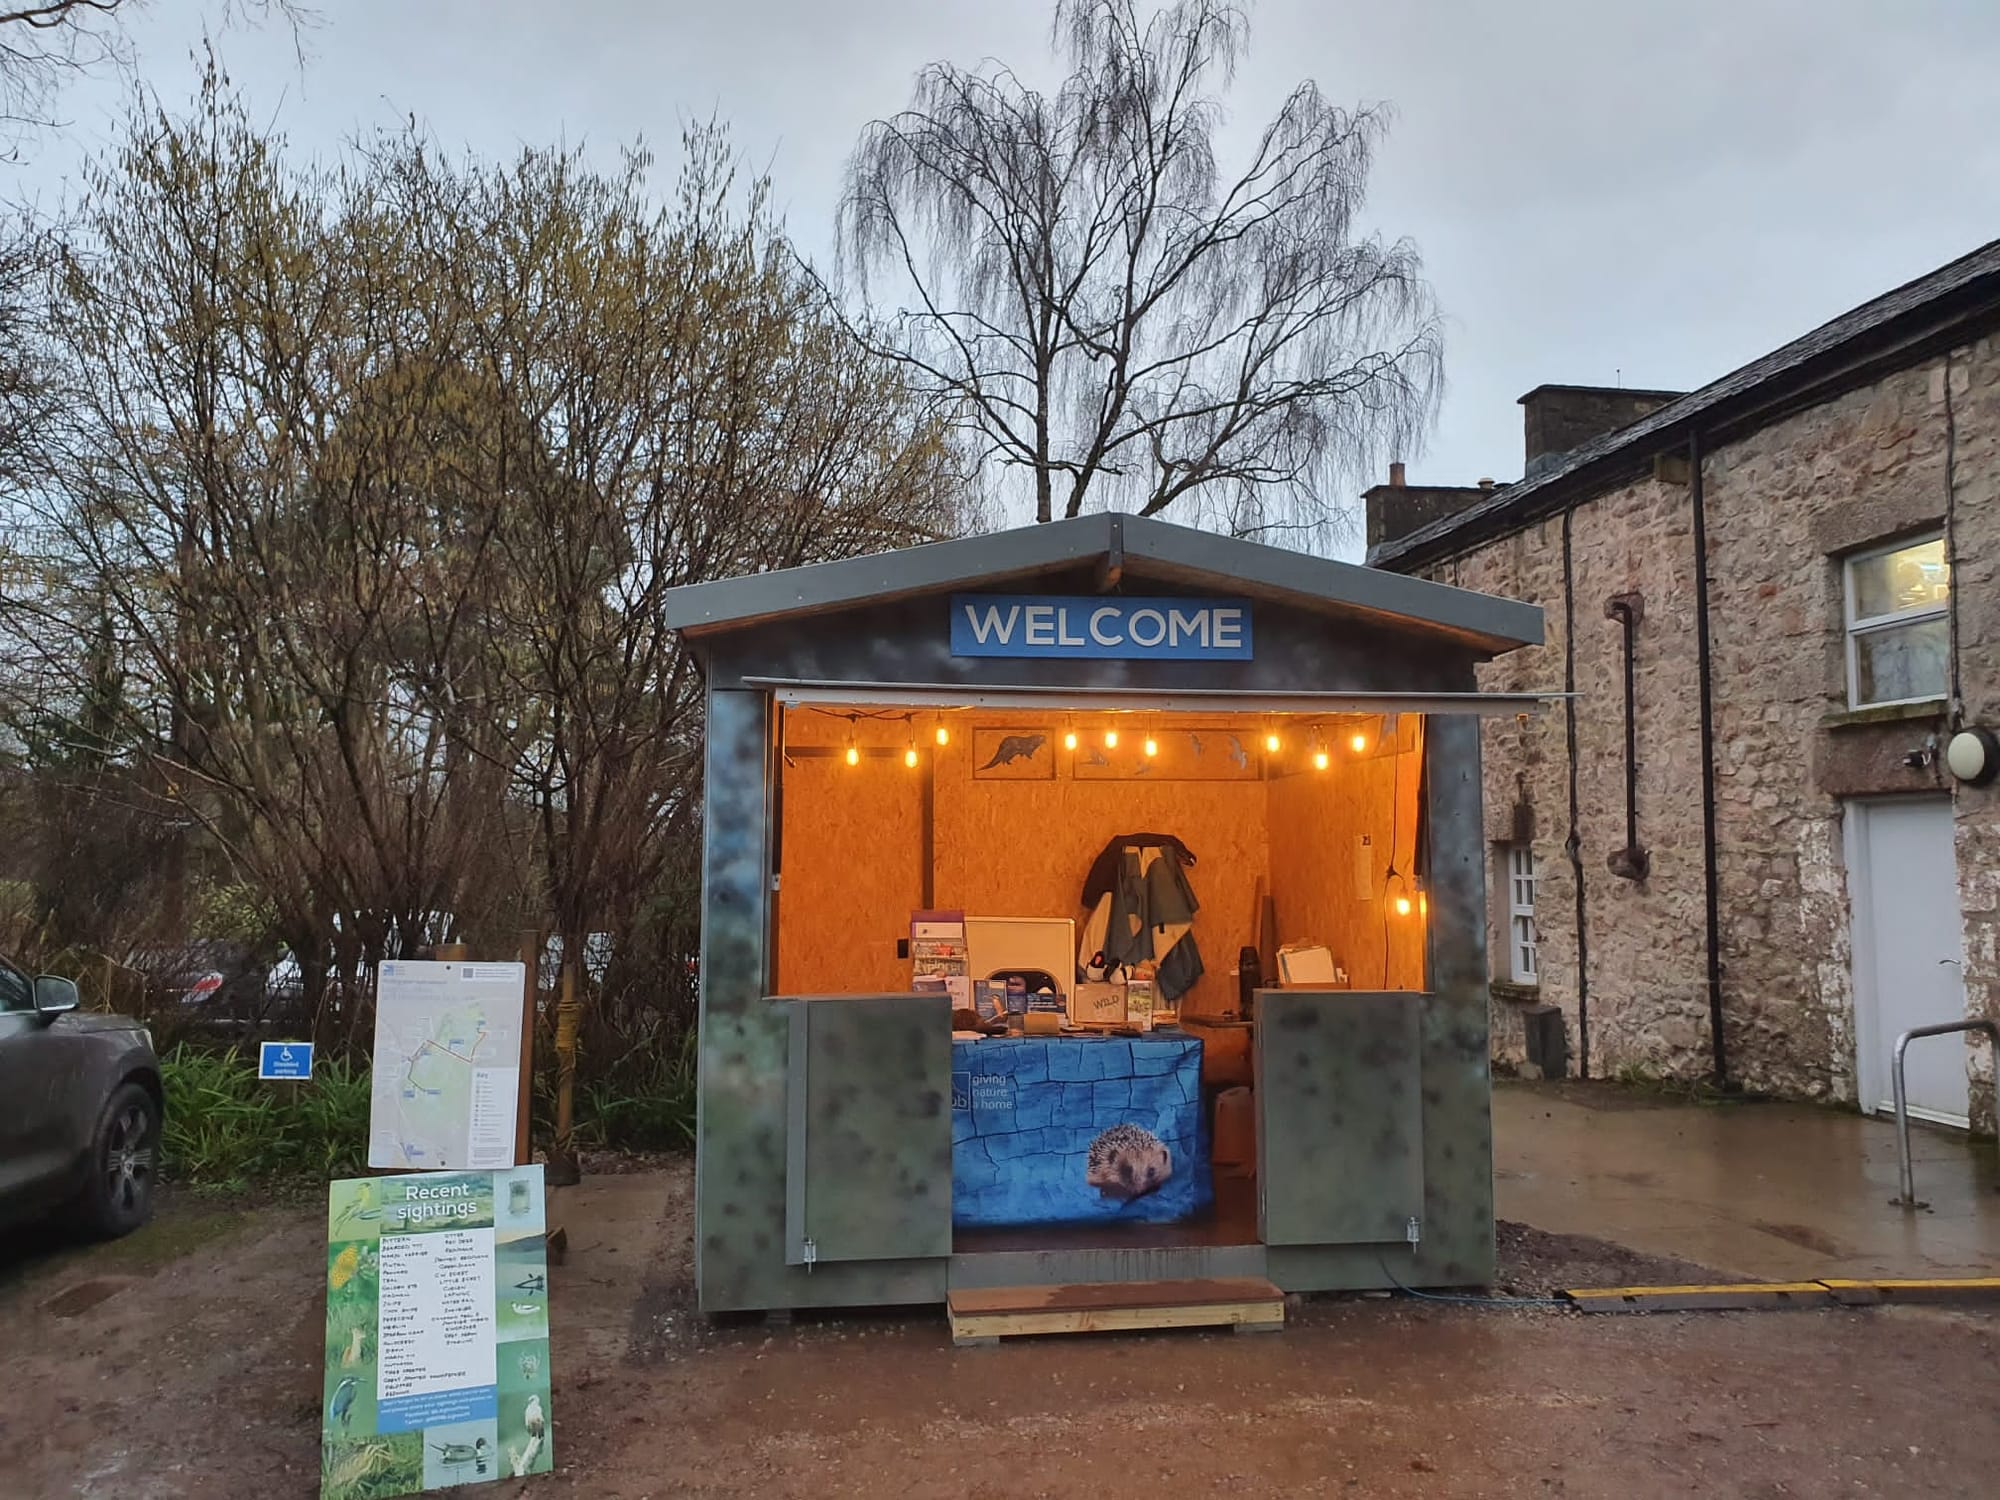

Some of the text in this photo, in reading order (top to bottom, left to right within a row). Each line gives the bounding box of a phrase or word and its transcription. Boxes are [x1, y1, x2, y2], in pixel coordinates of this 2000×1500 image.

[965, 604, 1242, 648] WELCOME
[972, 1073, 1006, 1087] giving
[972, 1087, 1008, 1097] nature
[981, 1099, 1013, 1110] home
[406, 1183, 470, 1201] Recent
[397, 1201, 478, 1223] sightings
